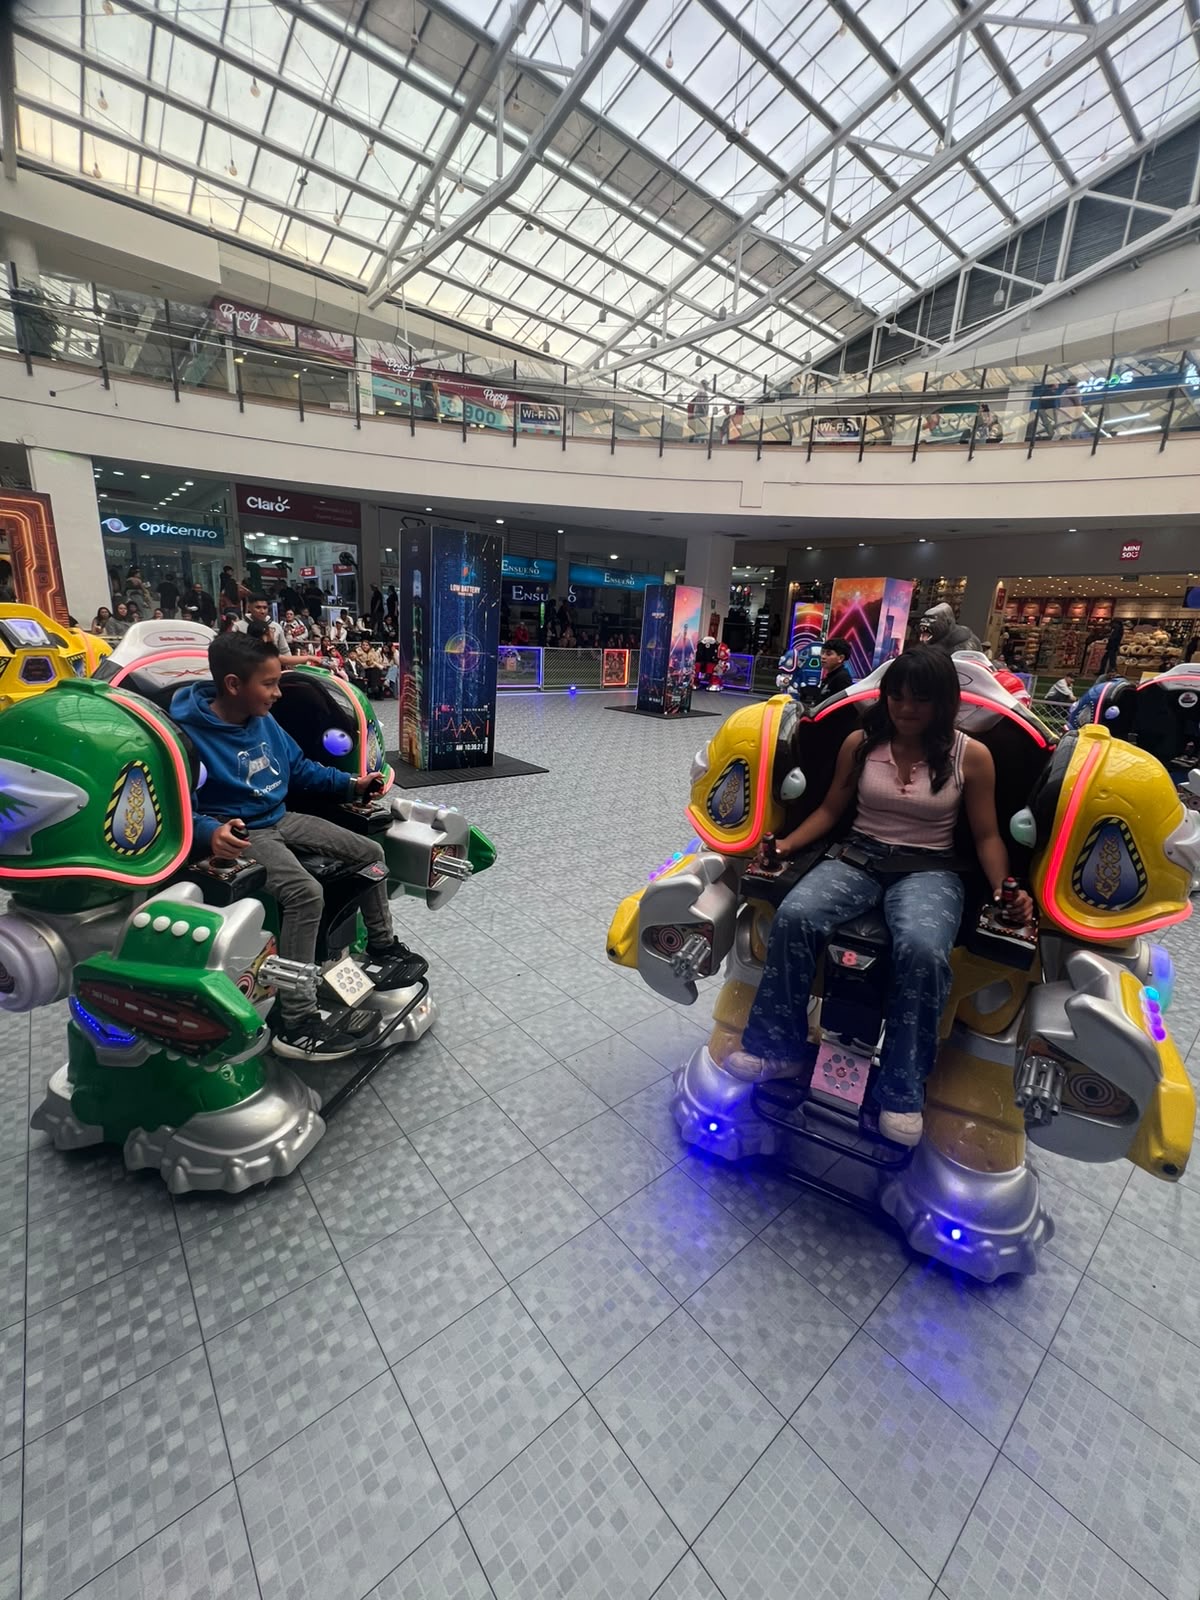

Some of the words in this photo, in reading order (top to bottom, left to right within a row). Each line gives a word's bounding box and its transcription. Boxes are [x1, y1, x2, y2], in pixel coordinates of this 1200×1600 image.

[483, 388, 509, 409] Popsy
[522, 408, 546, 420] Wi-Fi
[820, 422, 845, 432] Wi-Fi
[246, 496, 291, 513] Claro
[139, 522, 218, 540] opticentro
[461, 584, 481, 594] BATTERY
